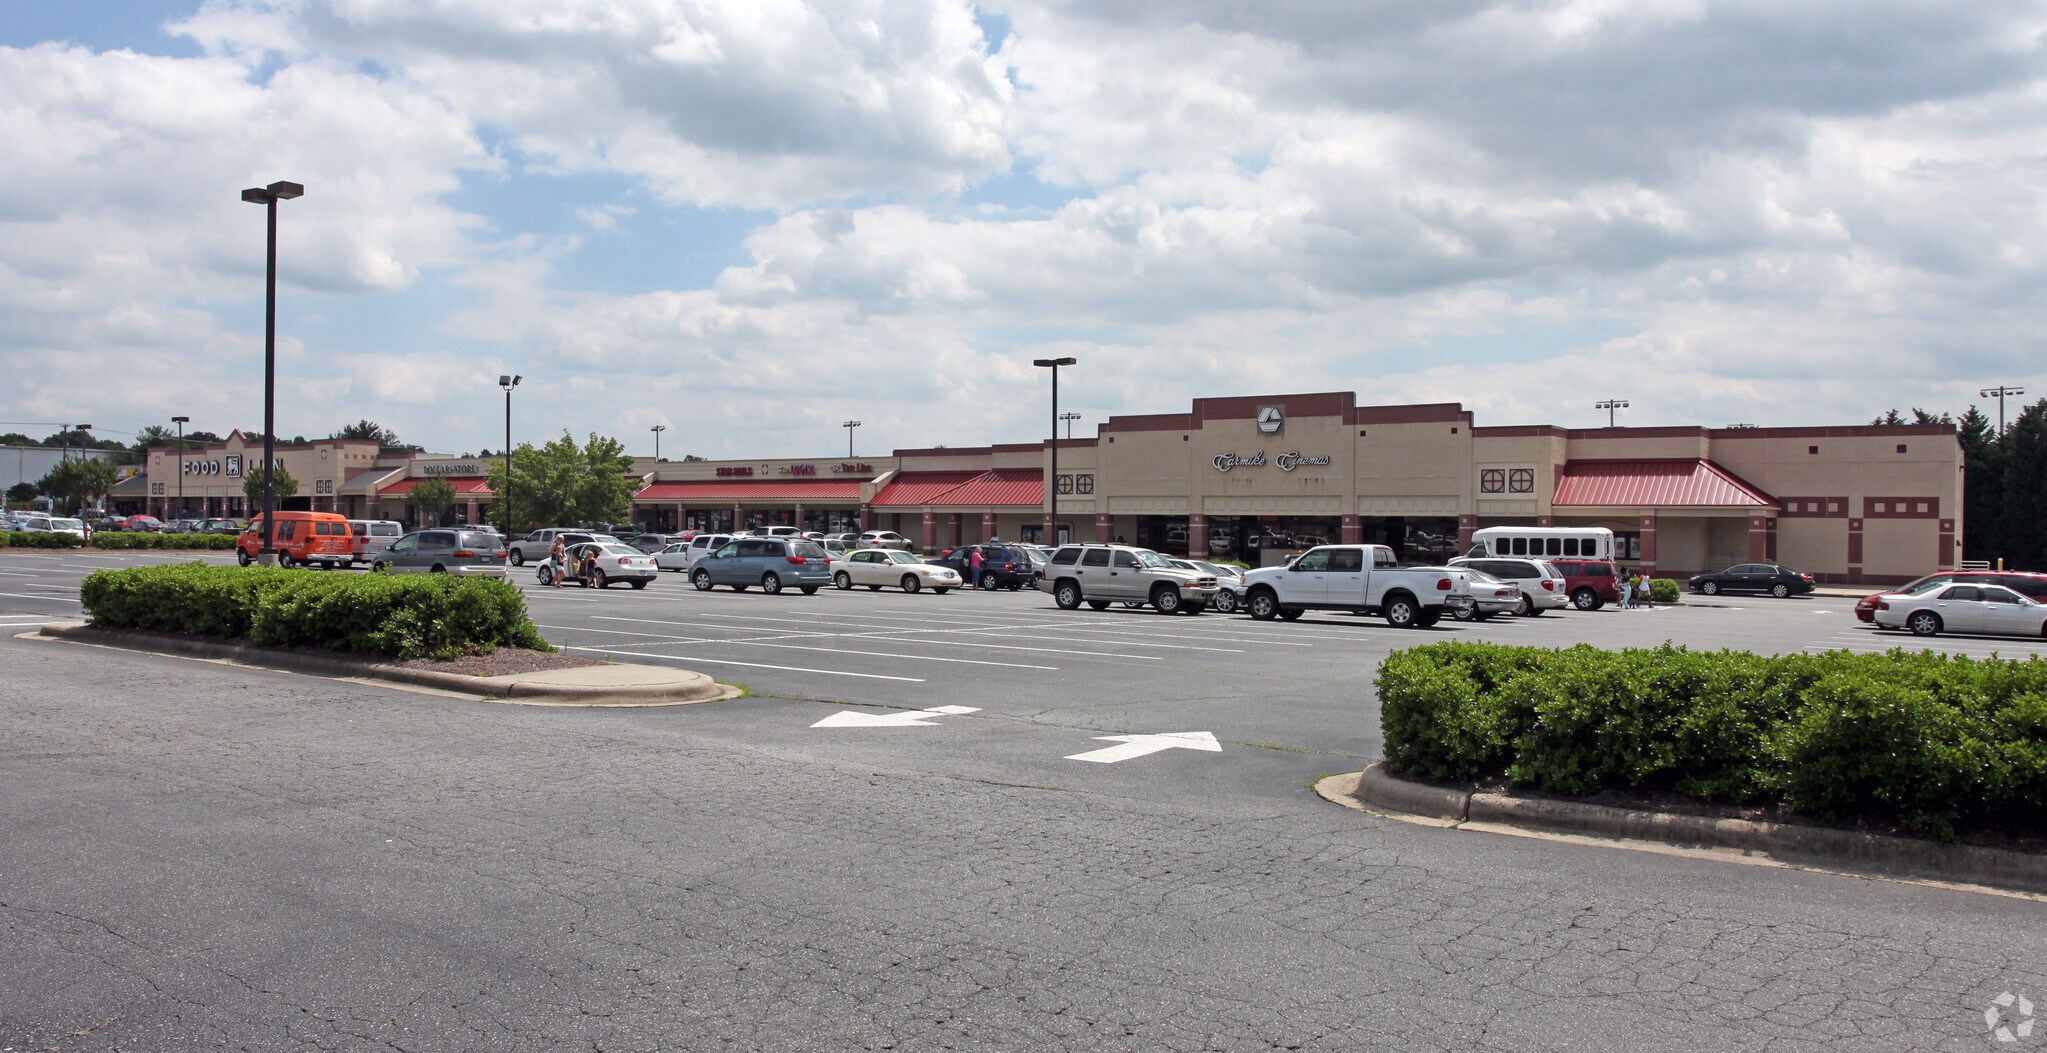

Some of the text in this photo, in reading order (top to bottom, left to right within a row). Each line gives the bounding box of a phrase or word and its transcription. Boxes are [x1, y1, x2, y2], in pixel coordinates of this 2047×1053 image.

[183, 458, 283, 475] FOOD LIN
[1212, 449, 1330, 472] Carmike Cinemas
